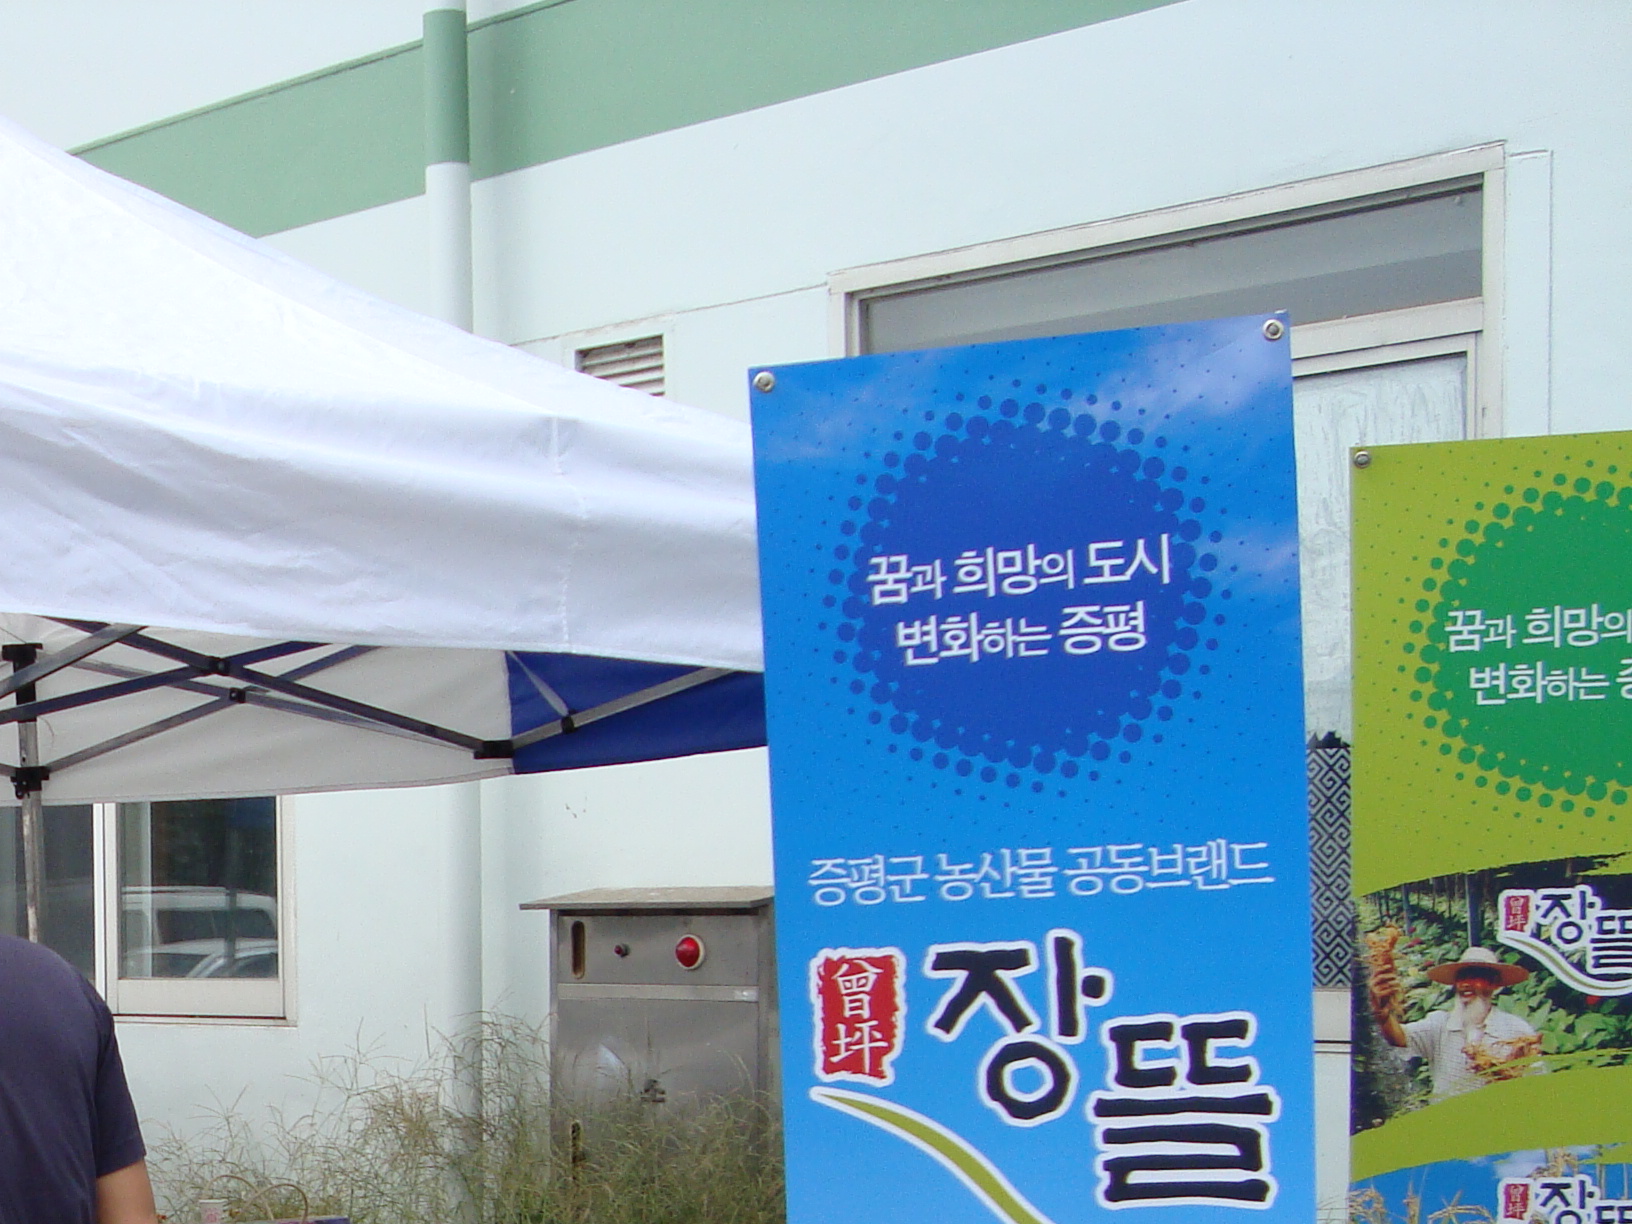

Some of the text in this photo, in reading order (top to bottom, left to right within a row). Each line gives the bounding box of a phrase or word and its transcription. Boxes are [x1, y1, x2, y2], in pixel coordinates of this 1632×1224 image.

[867, 533, 1171, 606] 꿈과 희망의 도시
[897, 600, 1147, 667] 변화하는 증평
[1444, 603, 1632, 653] 꿈과 희망의
[1469, 660, 1611, 705] 변화하는
[808, 838, 1275, 907] 증평군 농산물 공동브랜드
[830, 957, 889, 1076] 曾坪
[928, 934, 1276, 1205] 장뜰
